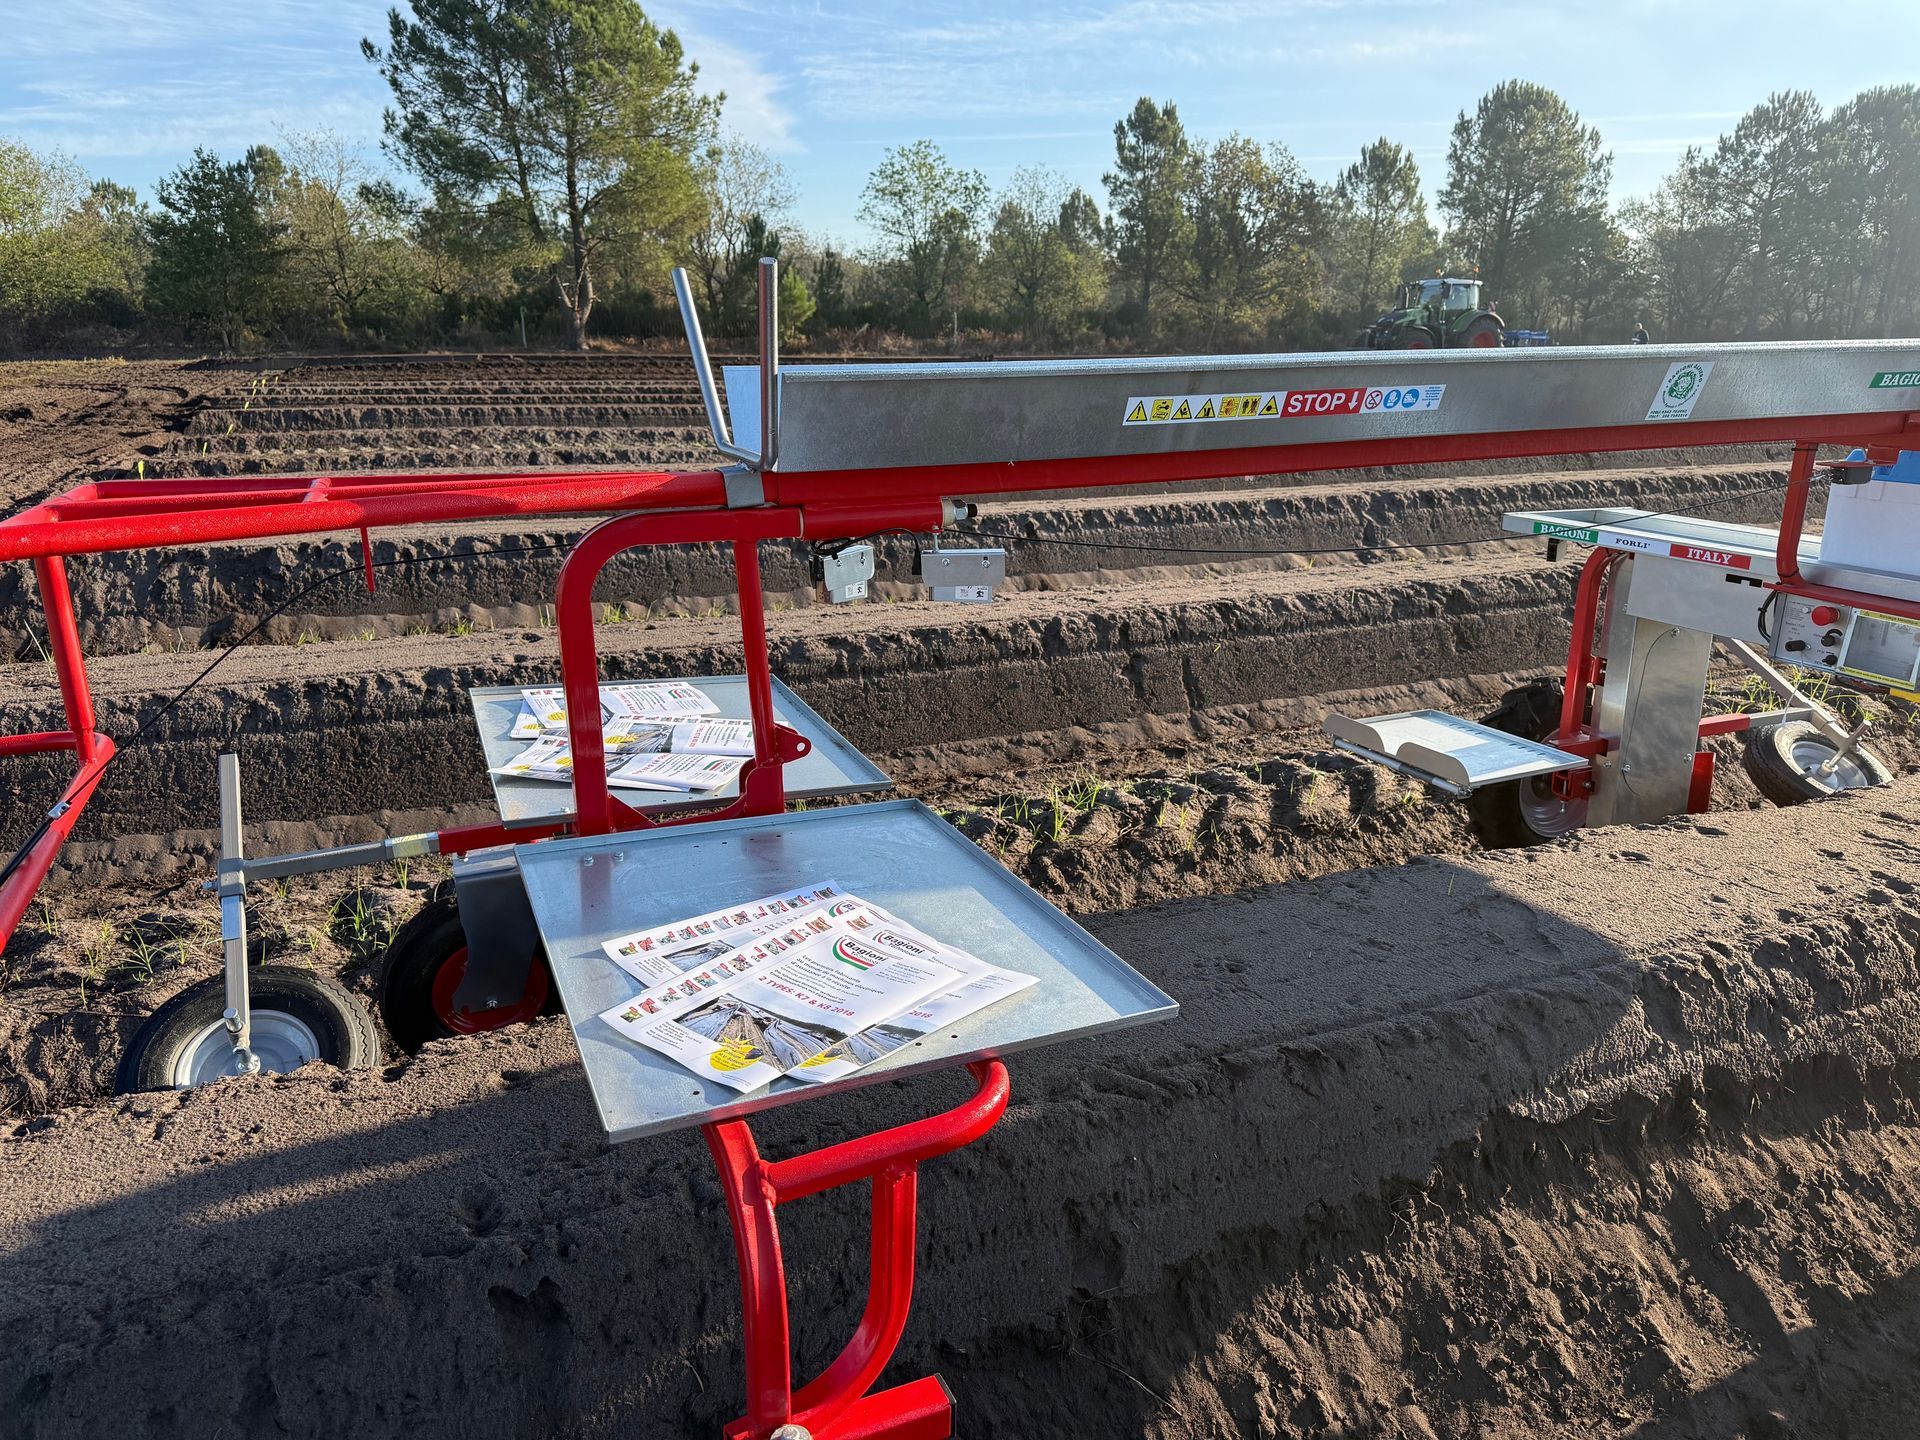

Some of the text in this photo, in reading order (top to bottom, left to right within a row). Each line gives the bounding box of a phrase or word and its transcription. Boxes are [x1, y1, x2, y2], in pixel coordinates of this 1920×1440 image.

[1287, 393, 1346, 413] STOP
[1540, 524, 1591, 541] BAGIONI
[1687, 548, 1733, 565] ITALY
[844, 941, 888, 962] Bagioni
[883, 935, 926, 955] Bagioni
[766, 980, 796, 995] TYPES:
[794, 992, 810, 1001] K7
[816, 1002, 832, 1010] K8
[830, 1007, 855, 1018] 2018
[908, 1009, 933, 1019] 2018
